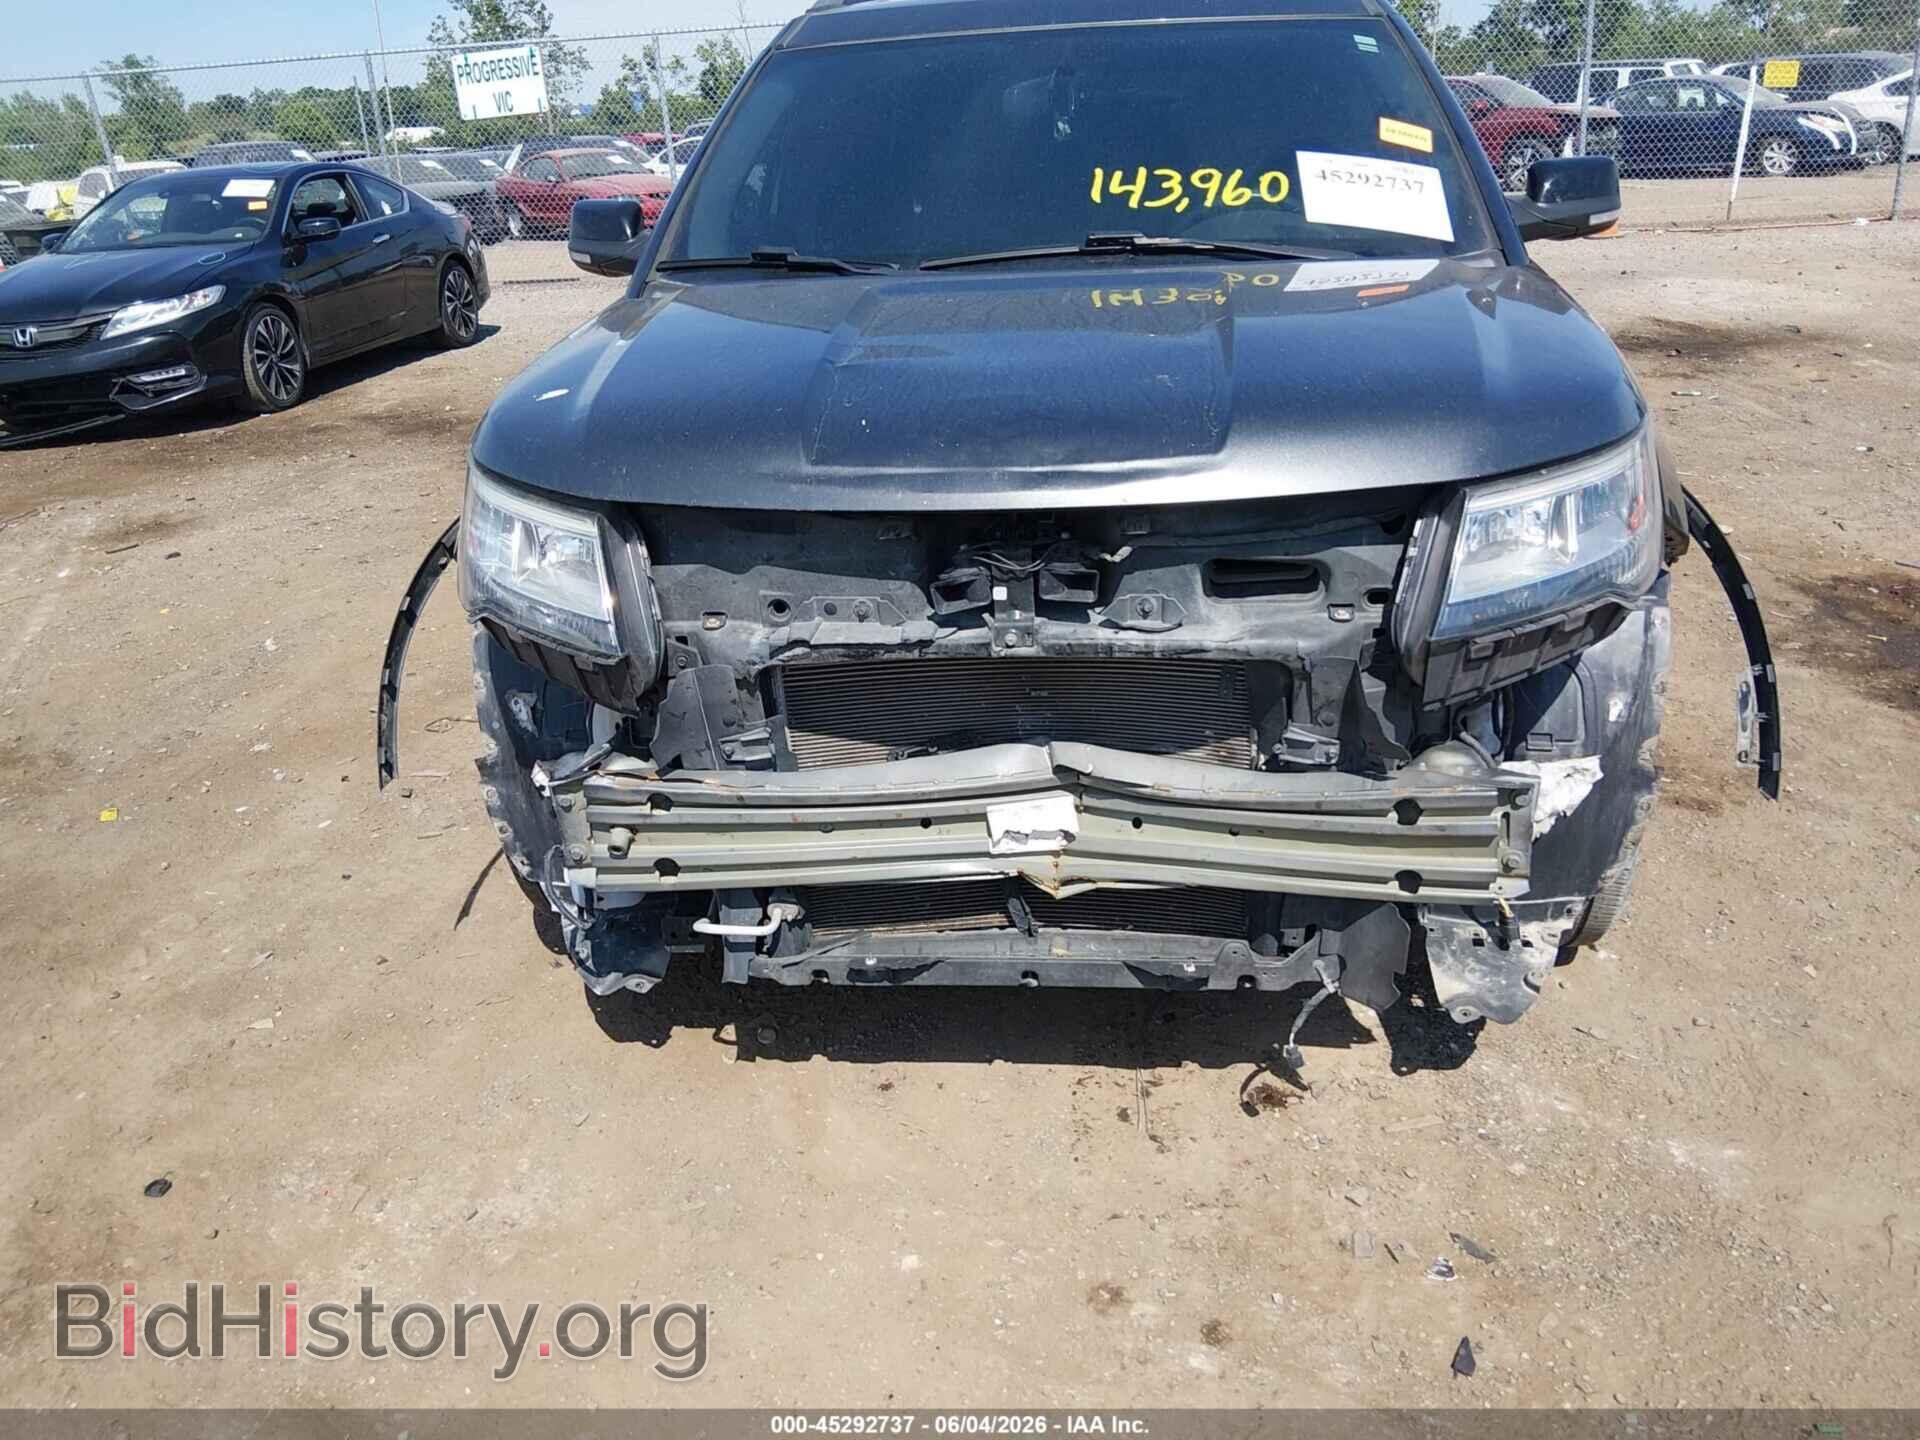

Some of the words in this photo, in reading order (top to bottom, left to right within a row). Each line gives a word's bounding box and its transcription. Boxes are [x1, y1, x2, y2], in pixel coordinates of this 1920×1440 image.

[456, 53, 540, 86] PROGRESSIVE
[492, 90, 514, 113] VIC
[1089, 166, 1290, 213] 143,960
[1315, 169, 1425, 194] 45292737
